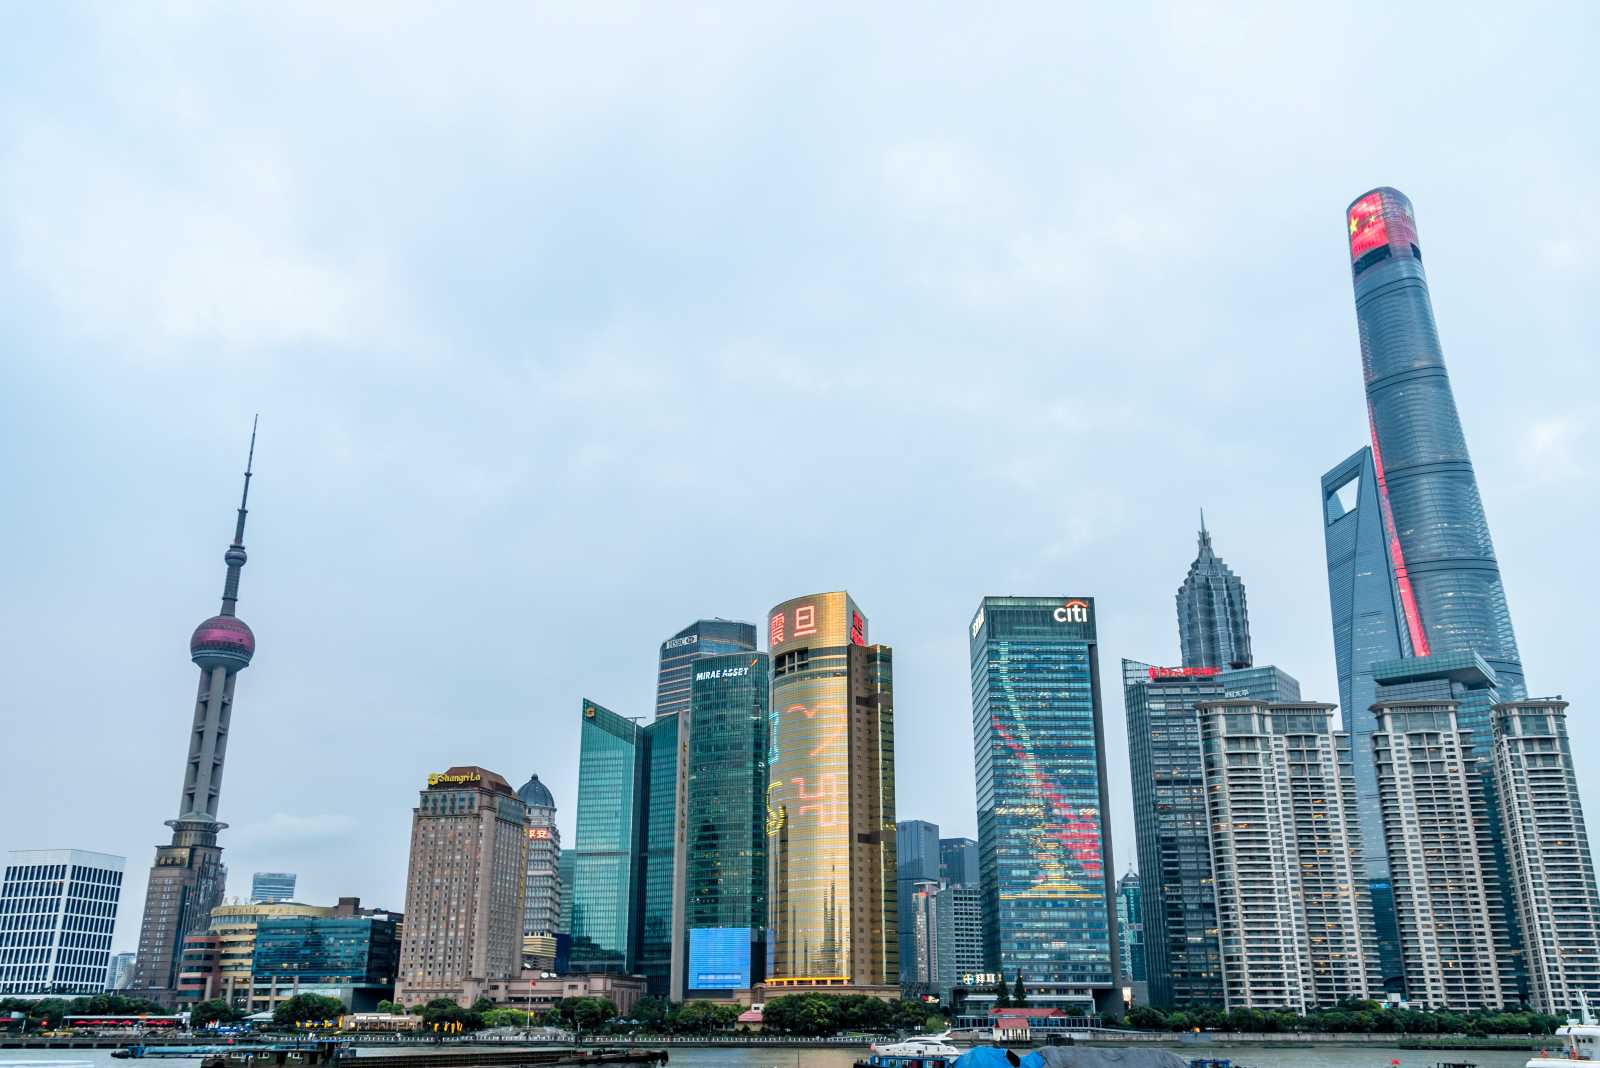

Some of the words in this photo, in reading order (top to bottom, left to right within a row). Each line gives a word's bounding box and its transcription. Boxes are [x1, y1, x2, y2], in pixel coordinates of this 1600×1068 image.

[1053, 601, 1088, 622] citi
[770, 604, 817, 648] 震旦
[696, 670, 721, 681] MIRAE
[722, 667, 749, 678] ASSET
